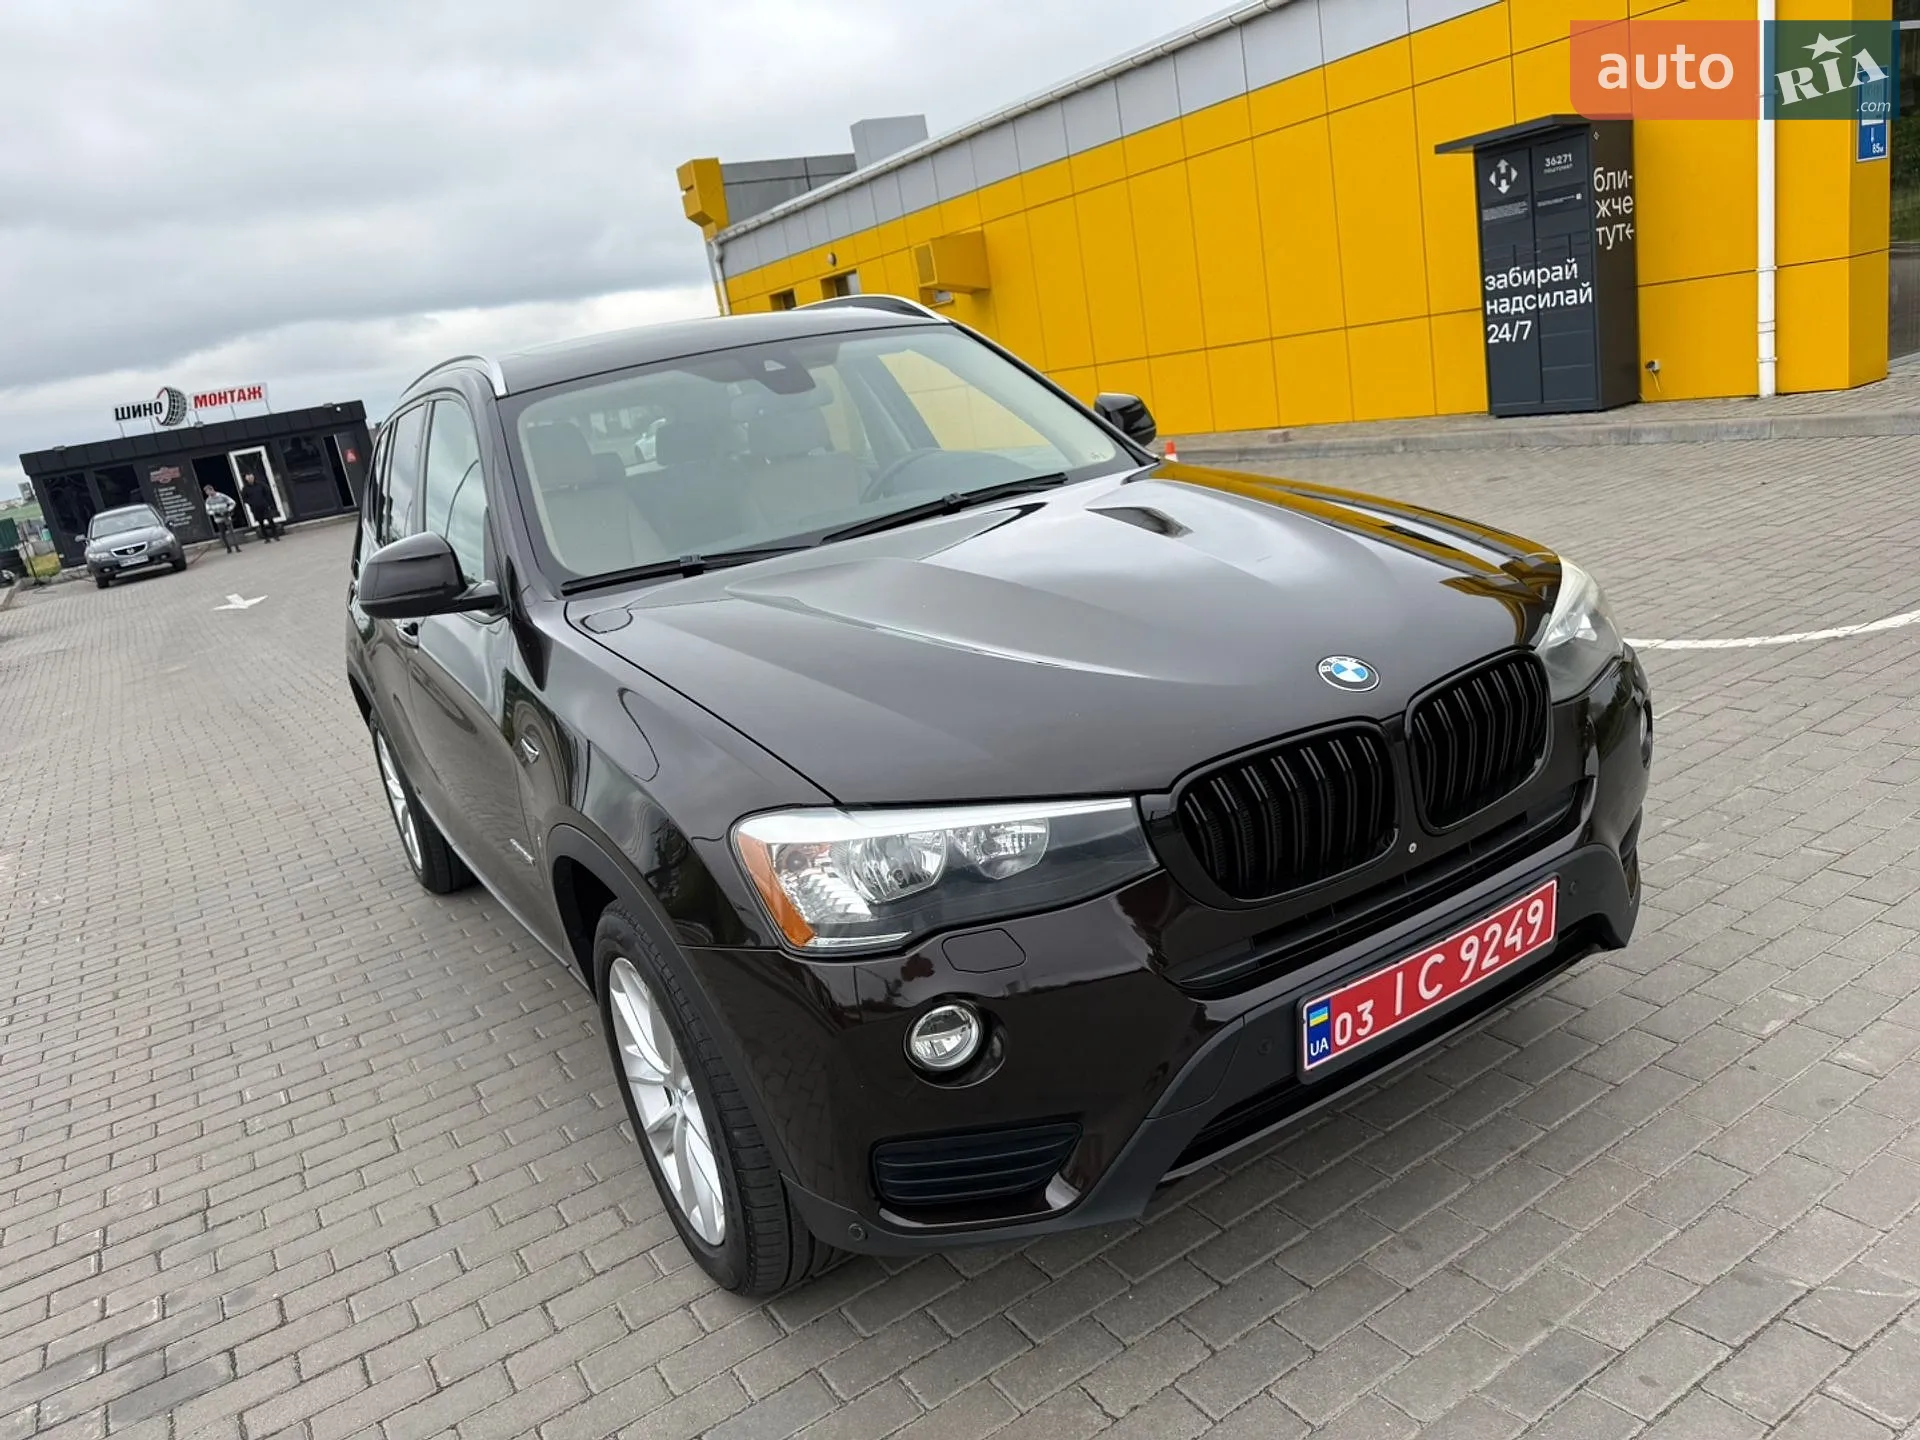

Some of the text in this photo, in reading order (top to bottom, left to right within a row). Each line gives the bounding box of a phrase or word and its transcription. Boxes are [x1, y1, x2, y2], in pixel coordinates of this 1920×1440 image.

[1544, 153, 1573, 168] 36271
[1593, 166, 1634, 193] бли-
[1595, 195, 1634, 219] жче
[1595, 222, 1627, 251] тут
[1484, 257, 1579, 291] забирай
[1486, 281, 1593, 315] надсилай
[1486, 319, 1533, 344] 24/7
[114, 385, 264, 422] ШИНО МОНТАЖ
[1333, 999, 1375, 1047] 03
[1459, 898, 1545, 984] 9249
[1309, 1036, 1330, 1057] UA
